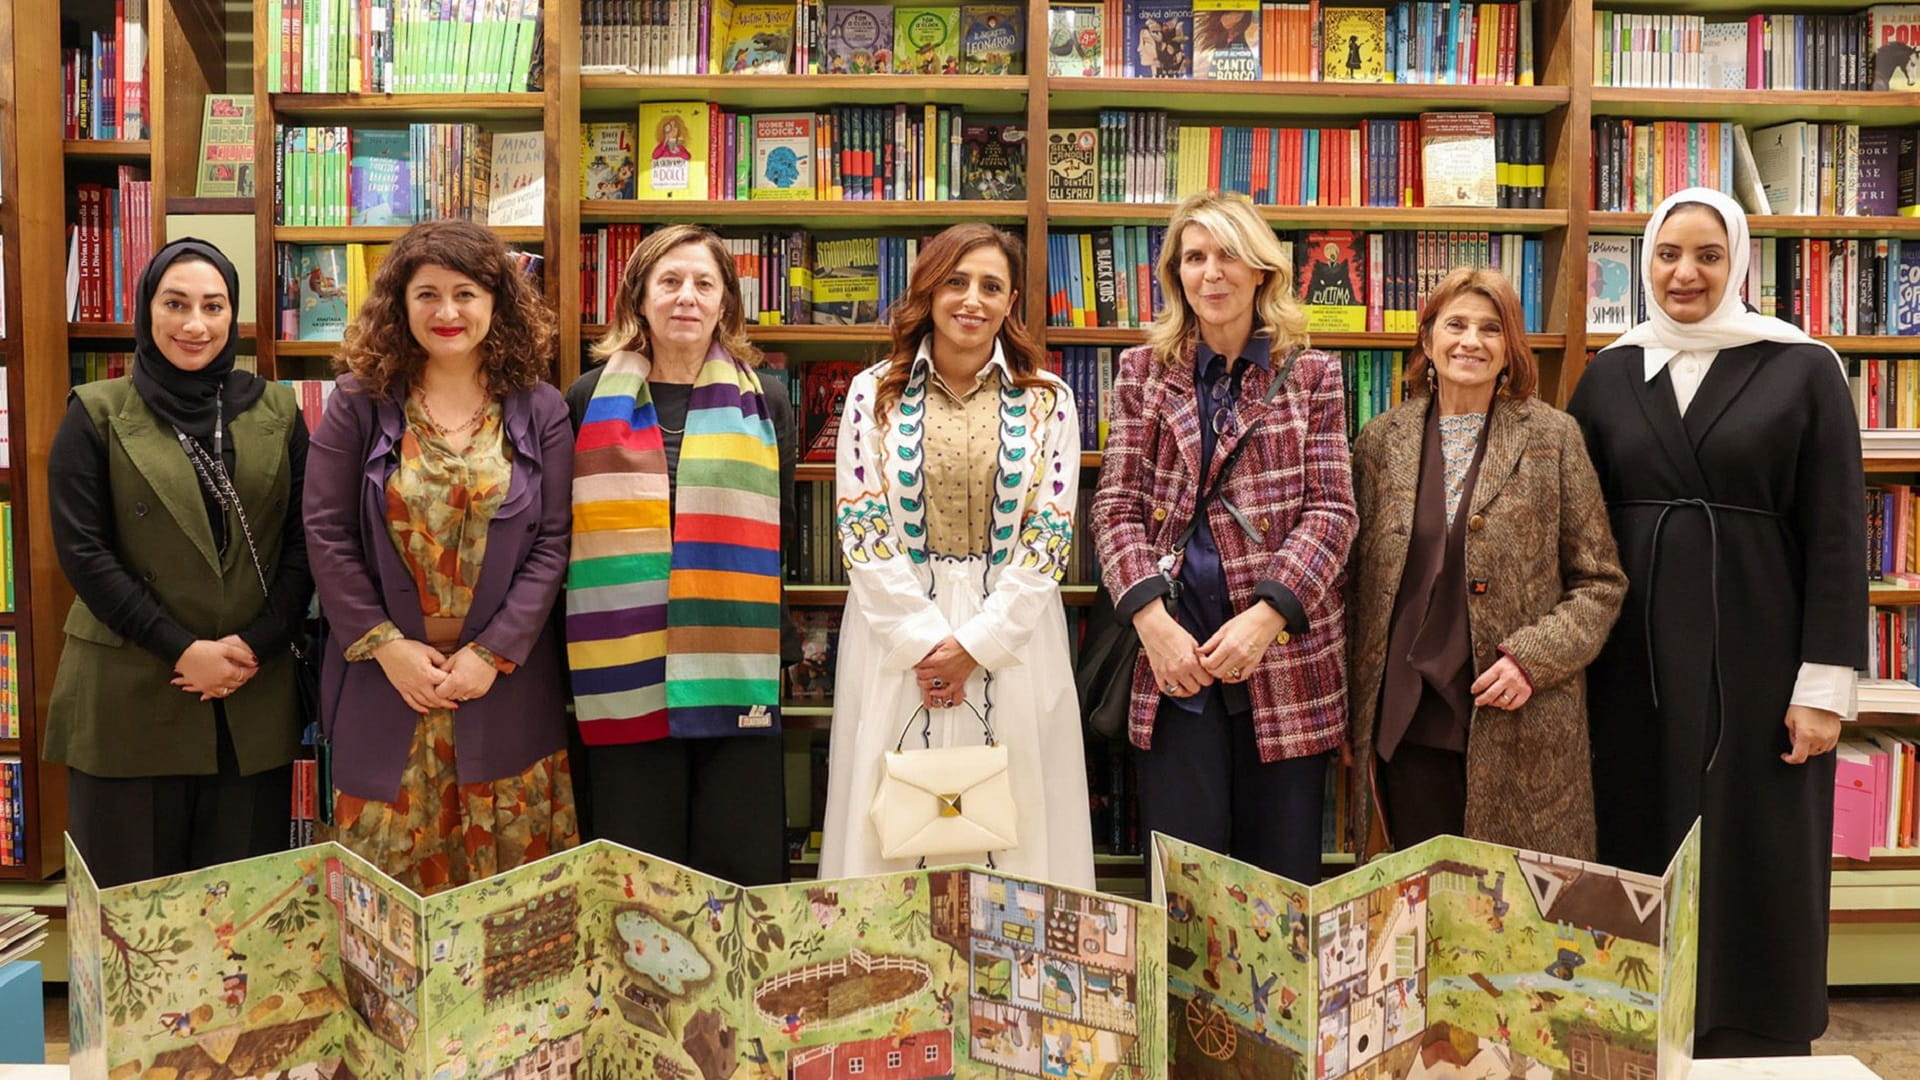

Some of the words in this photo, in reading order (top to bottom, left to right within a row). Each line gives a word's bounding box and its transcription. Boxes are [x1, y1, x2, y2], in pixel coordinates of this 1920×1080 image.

[1139, 9, 1161, 19] david
[1163, 9, 1193, 19] almond
[1882, 24, 1920, 47] PON
[966, 34, 1015, 57] LEONARDO
[1216, 59, 1254, 71] CANTO
[1216, 71, 1255, 81] BOSCO
[758, 121, 785, 129] NOME
[786, 120, 795, 128] IN
[758, 128, 795, 137] CODICE
[795, 126, 804, 136] X
[501, 137, 537, 150] MINO
[1050, 151, 1093, 164] GANDOLFI
[1859, 168, 1881, 178] ASE
[1050, 188, 1064, 199] GLI
[1065, 188, 1093, 200] SPARI
[1861, 191, 1886, 200] TRI
[79, 204, 88, 242] Commedia
[91, 204, 100, 242] Commedia
[1592, 240, 1629, 254] Blume
[80, 243, 89, 266] Divina
[92, 243, 101, 266] Divina
[1096, 248, 1114, 280] BLACK
[81, 269, 89, 277] La
[92, 269, 101, 277] La
[1096, 279, 1115, 303] KIDS
